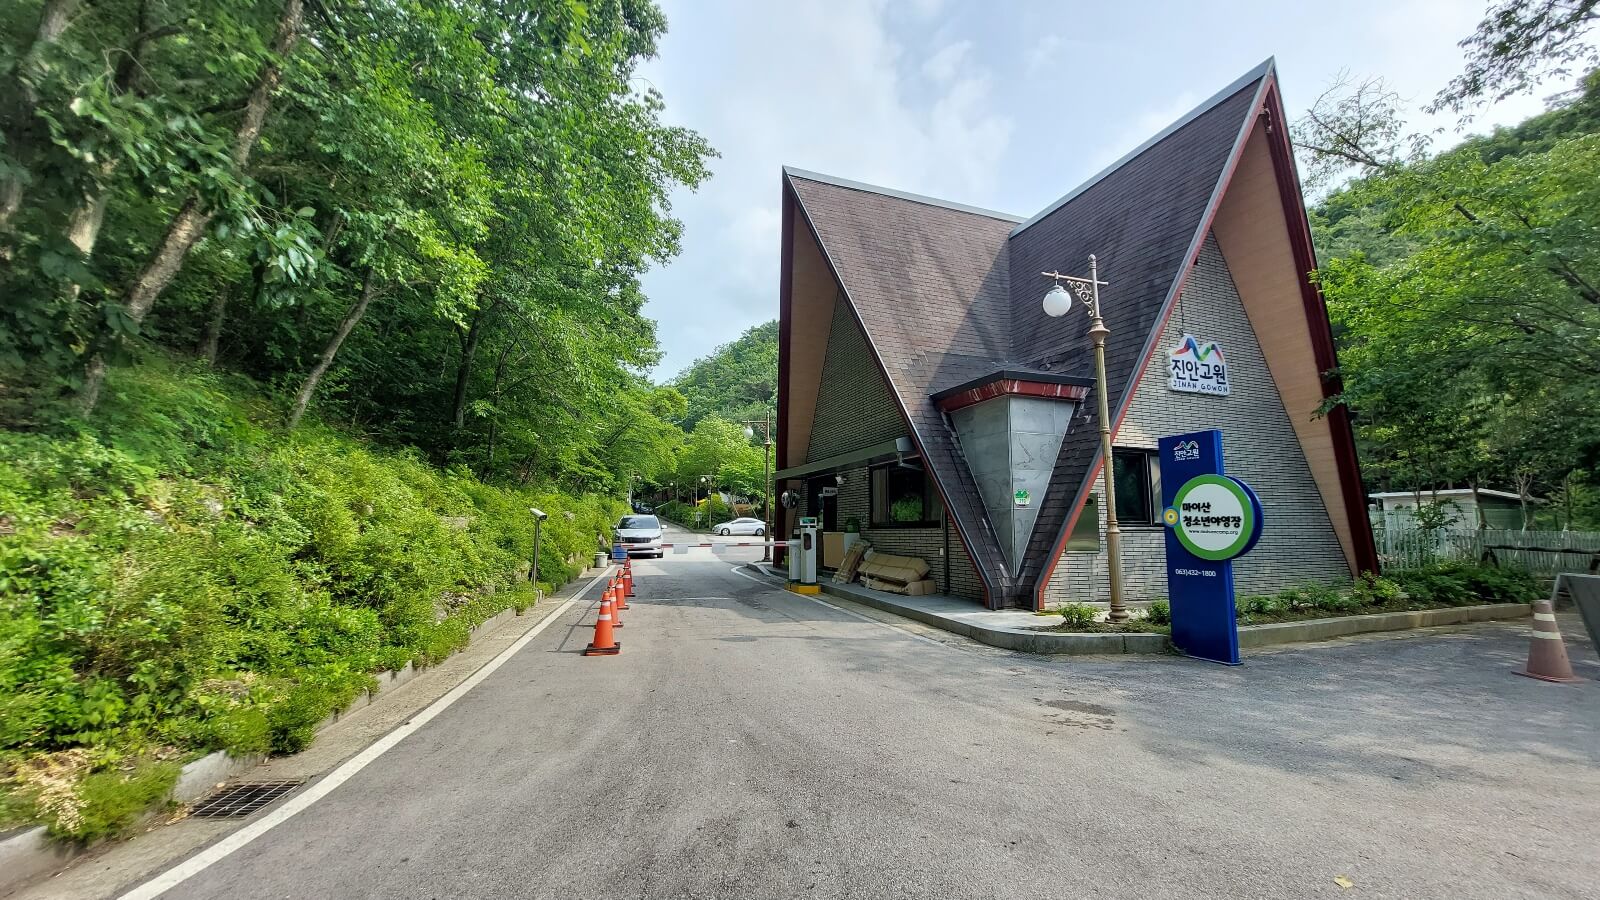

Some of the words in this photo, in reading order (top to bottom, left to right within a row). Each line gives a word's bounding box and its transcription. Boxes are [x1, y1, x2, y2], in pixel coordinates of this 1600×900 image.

[1172, 359, 1226, 385] 진안고원
[1173, 380, 1197, 389] JINAN
[1201, 383, 1228, 392] GOWON
[1182, 502, 1211, 513] 마이산
[1183, 515, 1241, 528] 청소년야영장
